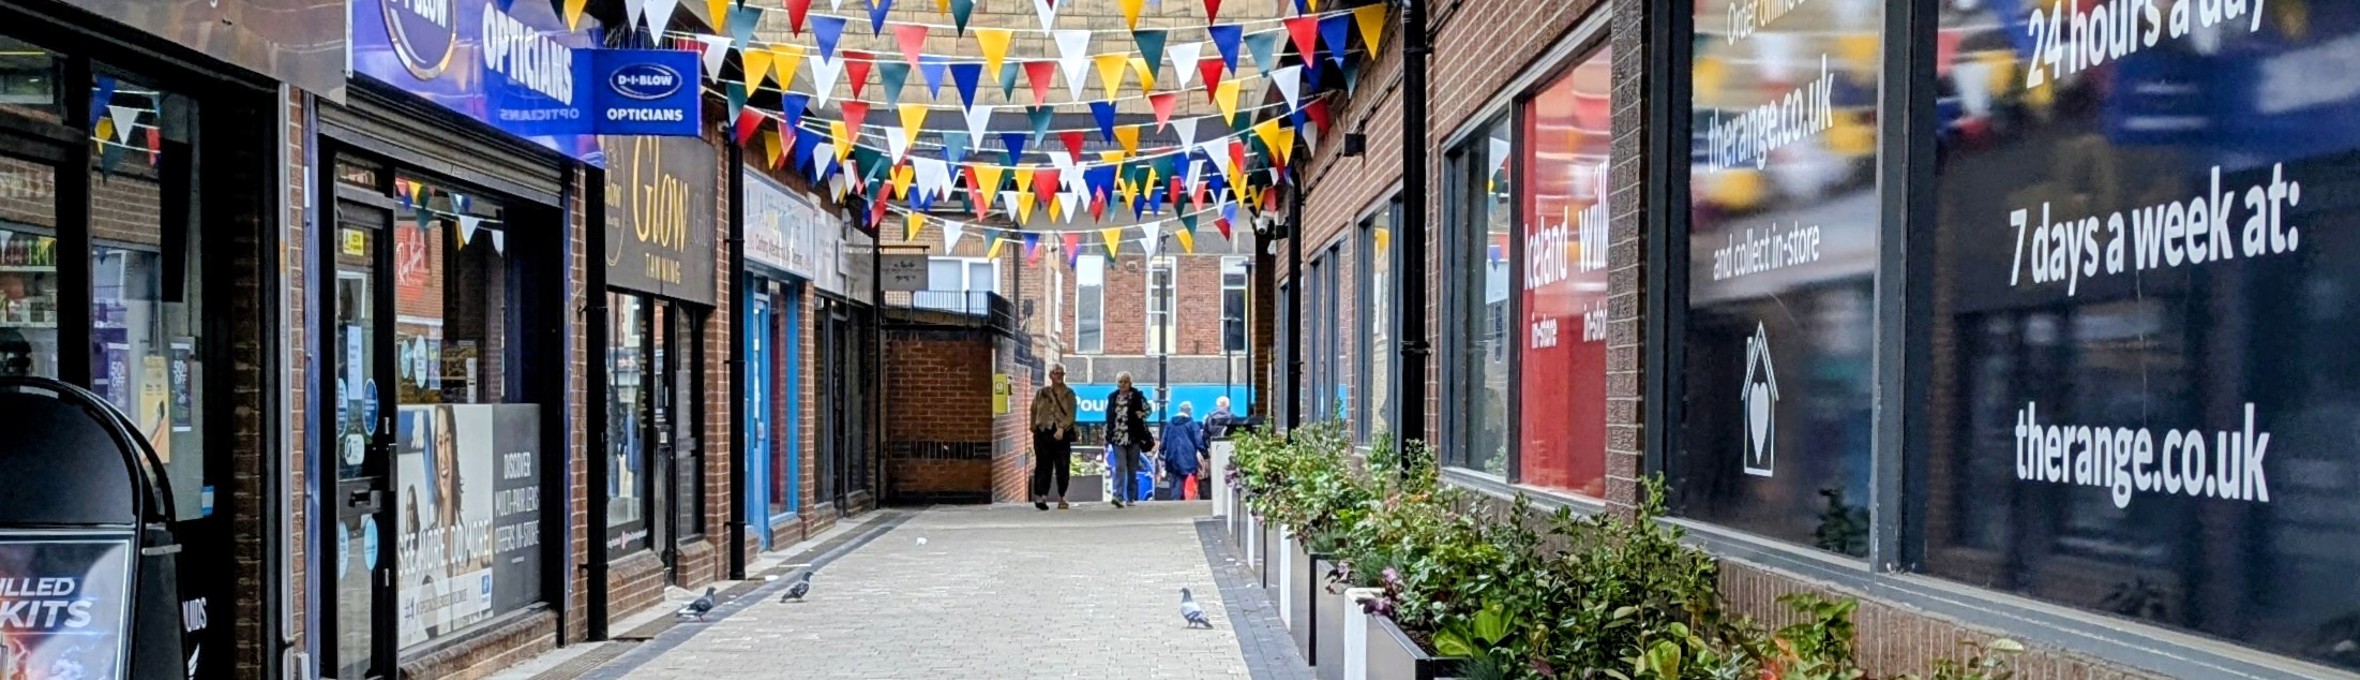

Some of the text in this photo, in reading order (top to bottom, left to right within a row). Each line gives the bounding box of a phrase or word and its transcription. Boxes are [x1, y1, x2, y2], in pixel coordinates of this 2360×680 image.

[482, 2, 572, 106] OPTICIANS
[1727, 0, 1757, 46] Order
[2026, 0, 2063, 89] 24
[2069, 0, 2161, 74] hours
[607, 108, 683, 121] OPTICIANS
[1708, 53, 1834, 173] therange.co.uk
[633, 135, 688, 253] Glow
[2010, 162, 2300, 297] 7 days a week at:
[646, 253, 680, 284] TANNING
[1524, 205, 1568, 290] Iceland
[1713, 221, 1820, 281] and collect in-store
[1531, 311, 1558, 349] in-store
[2015, 401, 2270, 509] therange.co.uk
[0, 600, 93, 628] KITS
